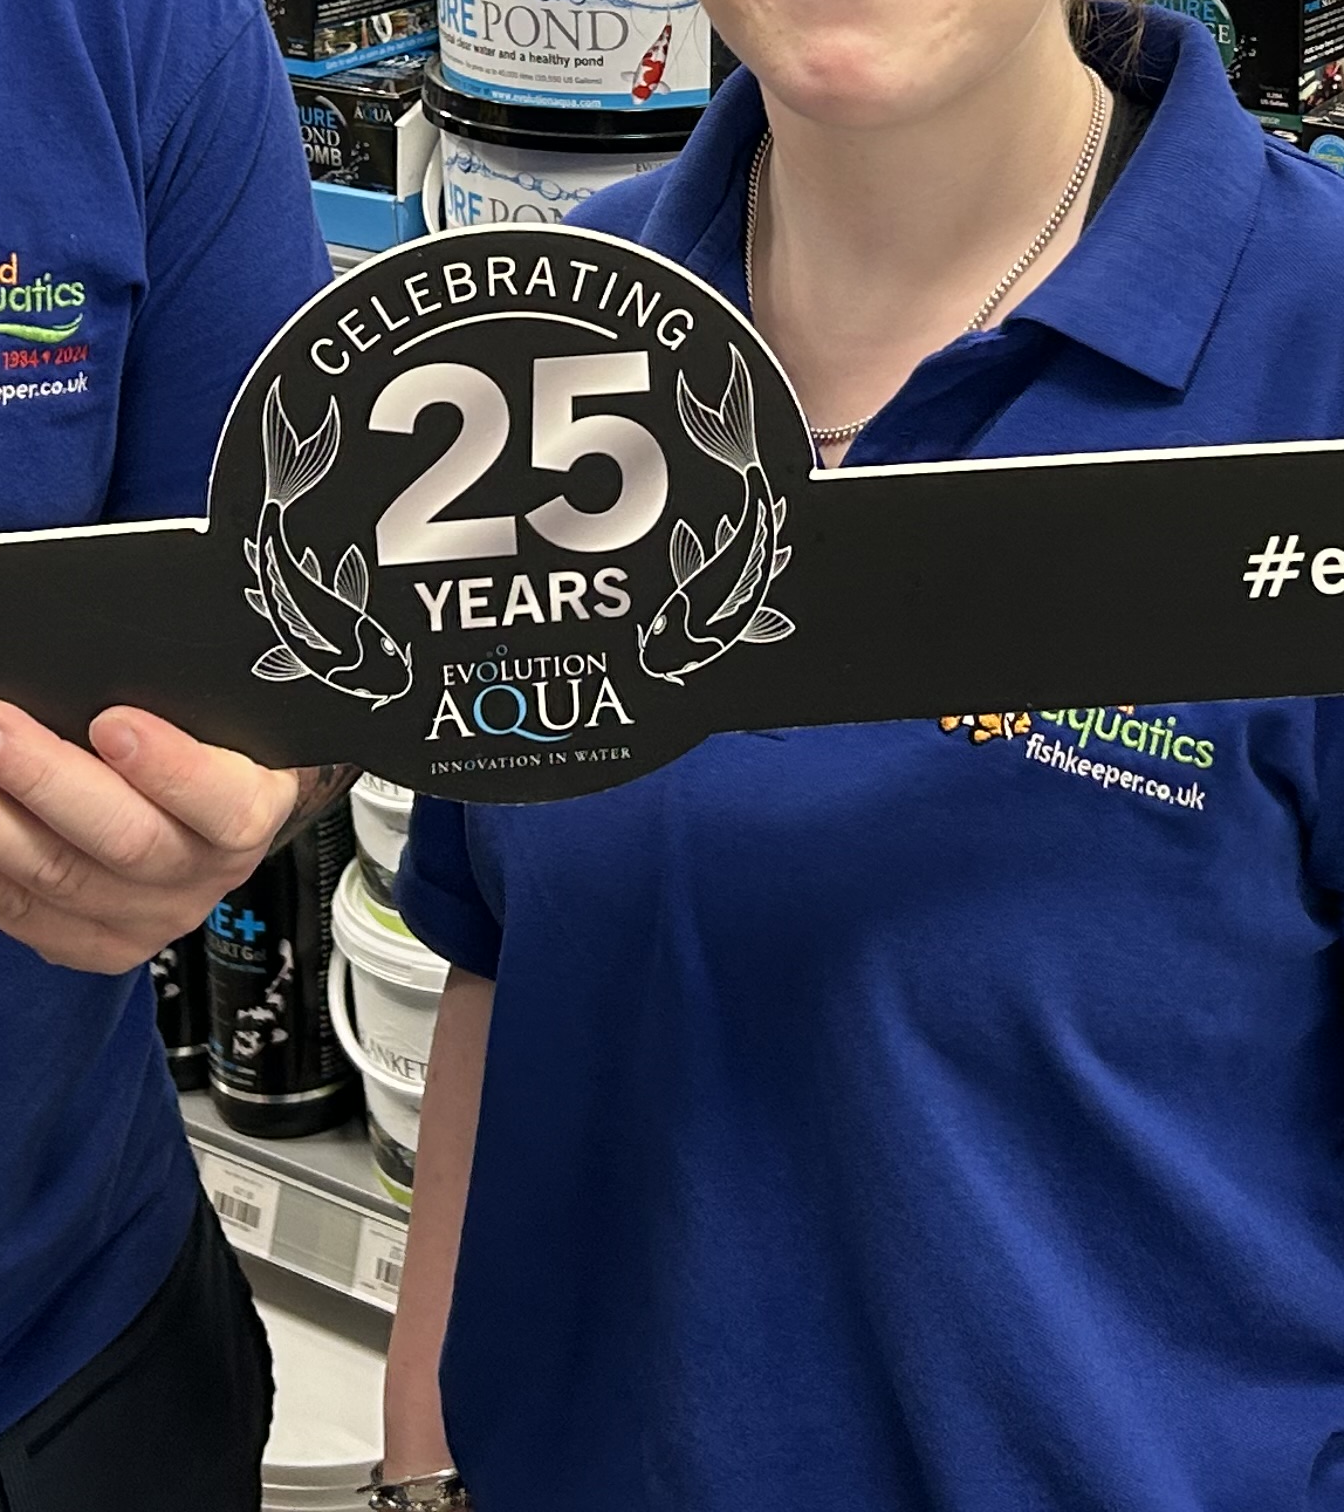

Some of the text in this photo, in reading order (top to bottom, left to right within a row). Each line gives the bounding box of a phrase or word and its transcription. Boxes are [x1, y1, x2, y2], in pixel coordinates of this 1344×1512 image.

[479, 0, 630, 52] POND
[473, 44, 496, 59] water
[498, 50, 517, 62] and
[529, 51, 571, 68] healthy
[574, 55, 604, 69] pond
[353, 105, 394, 123] AQUA
[491, 90, 603, 108] www.evolutionaqua.com
[300, 126, 341, 147] OND
[306, 143, 343, 168] OMB
[310, 255, 695, 376] CELEBRATING
[1, 349, 40, 370] 1984
[54, 345, 89, 365] 2024
[368, 350, 669, 567] 25
[413, 567, 632, 633] YEARS
[442, 652, 609, 687] EVOLUTION
[424, 676, 636, 743] AQUA
[430, 746, 632, 776] INNOVATION IN WATER
[1025, 731, 1206, 811] fishkeeper.co.uk
